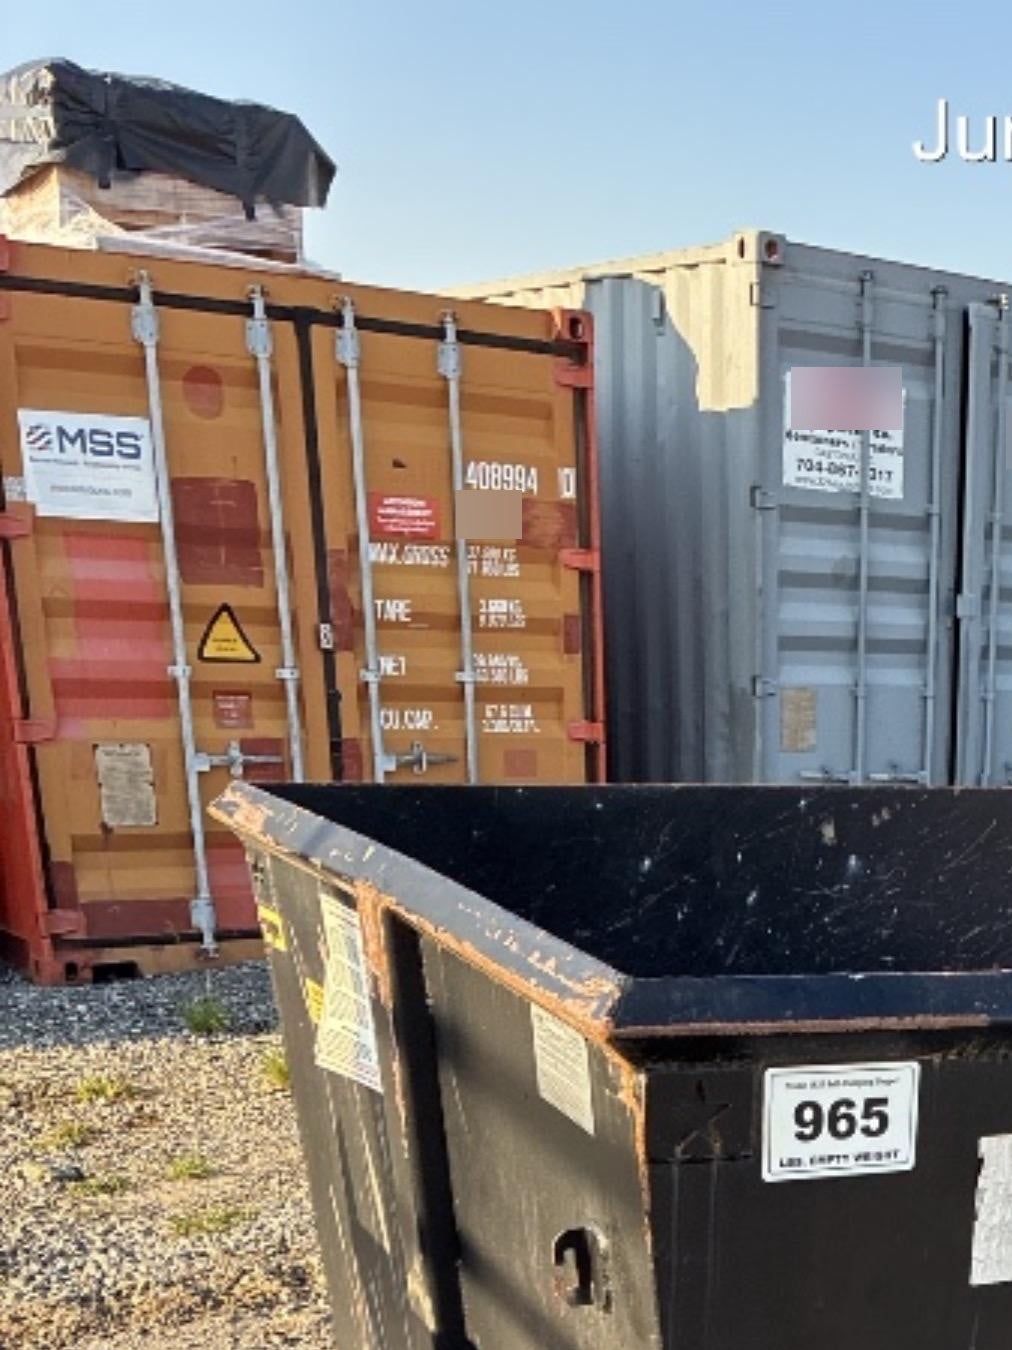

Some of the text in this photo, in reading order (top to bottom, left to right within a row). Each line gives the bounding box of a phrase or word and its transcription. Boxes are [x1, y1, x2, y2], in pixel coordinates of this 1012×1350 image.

[56, 425, 142, 459] MSS
[375, 600, 412, 622] TARE
[794, 1097, 889, 1142] 965
[809, 1154, 850, 1166] EMPTY
[853, 1149, 900, 1163] WEIGHT
